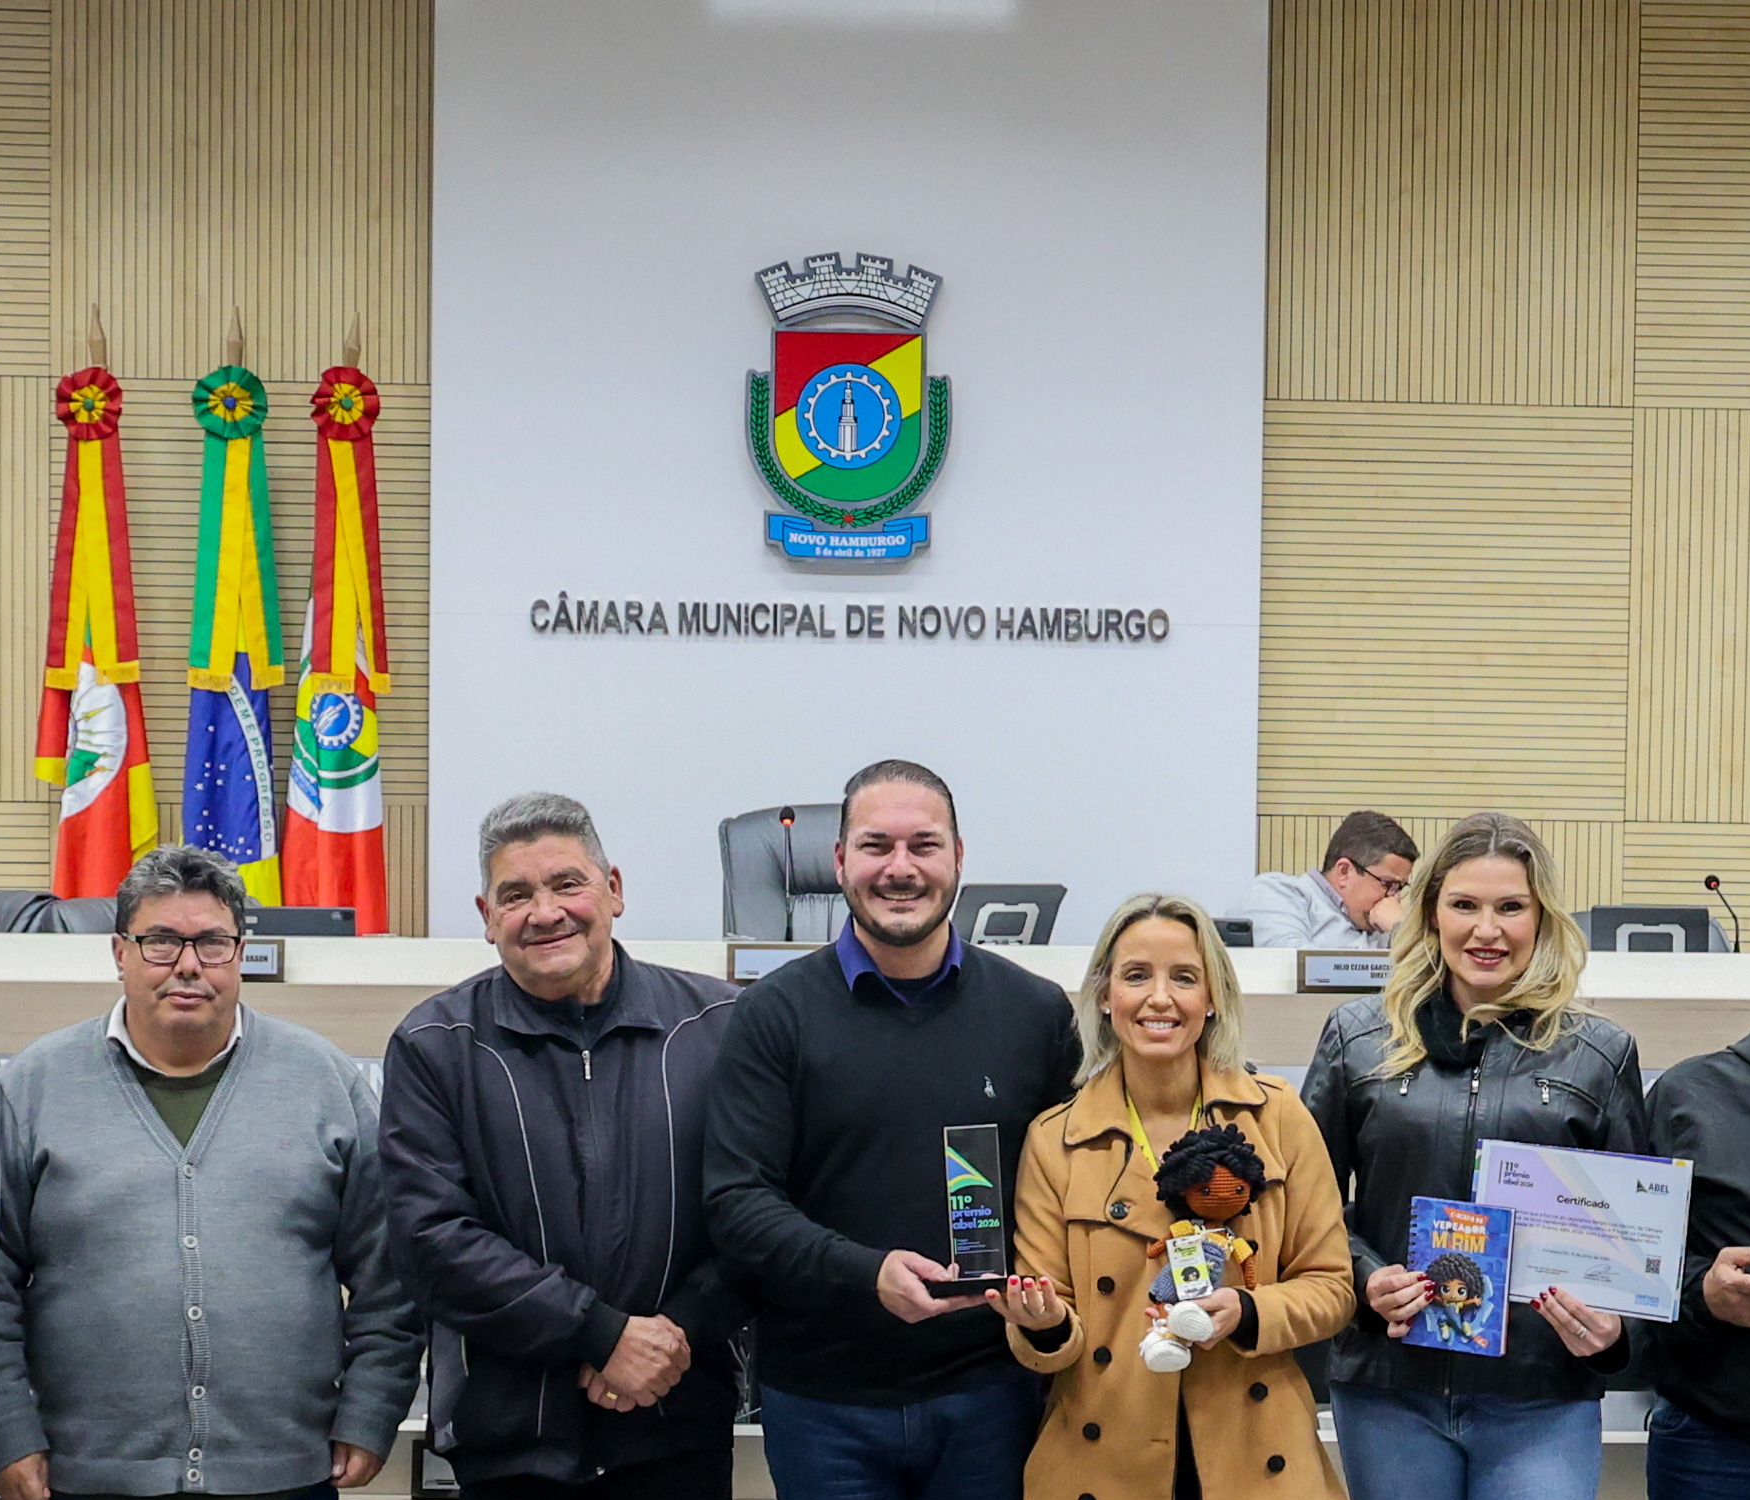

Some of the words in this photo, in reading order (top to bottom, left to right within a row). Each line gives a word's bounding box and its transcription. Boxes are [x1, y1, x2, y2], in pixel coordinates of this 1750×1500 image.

[789, 532, 826, 545] NOVO
[830, 535, 905, 547] HAMBURGO
[530, 592, 668, 636] CÂMARA
[678, 603, 834, 639] MUNICIPAL
[846, 605, 884, 640] DE
[898, 606, 987, 641] NOVO
[996, 608, 1170, 644] HAMBURGO
[249, 736, 272, 842] PROGRESSO
[1648, 1182, 1670, 1193] ABEL
[950, 1195, 972, 1210] 11º
[1557, 1195, 1610, 1209] Certificado
[952, 1206, 992, 1220] prêmio
[953, 1218, 976, 1230] abel
[978, 1218, 1000, 1228] 2026
